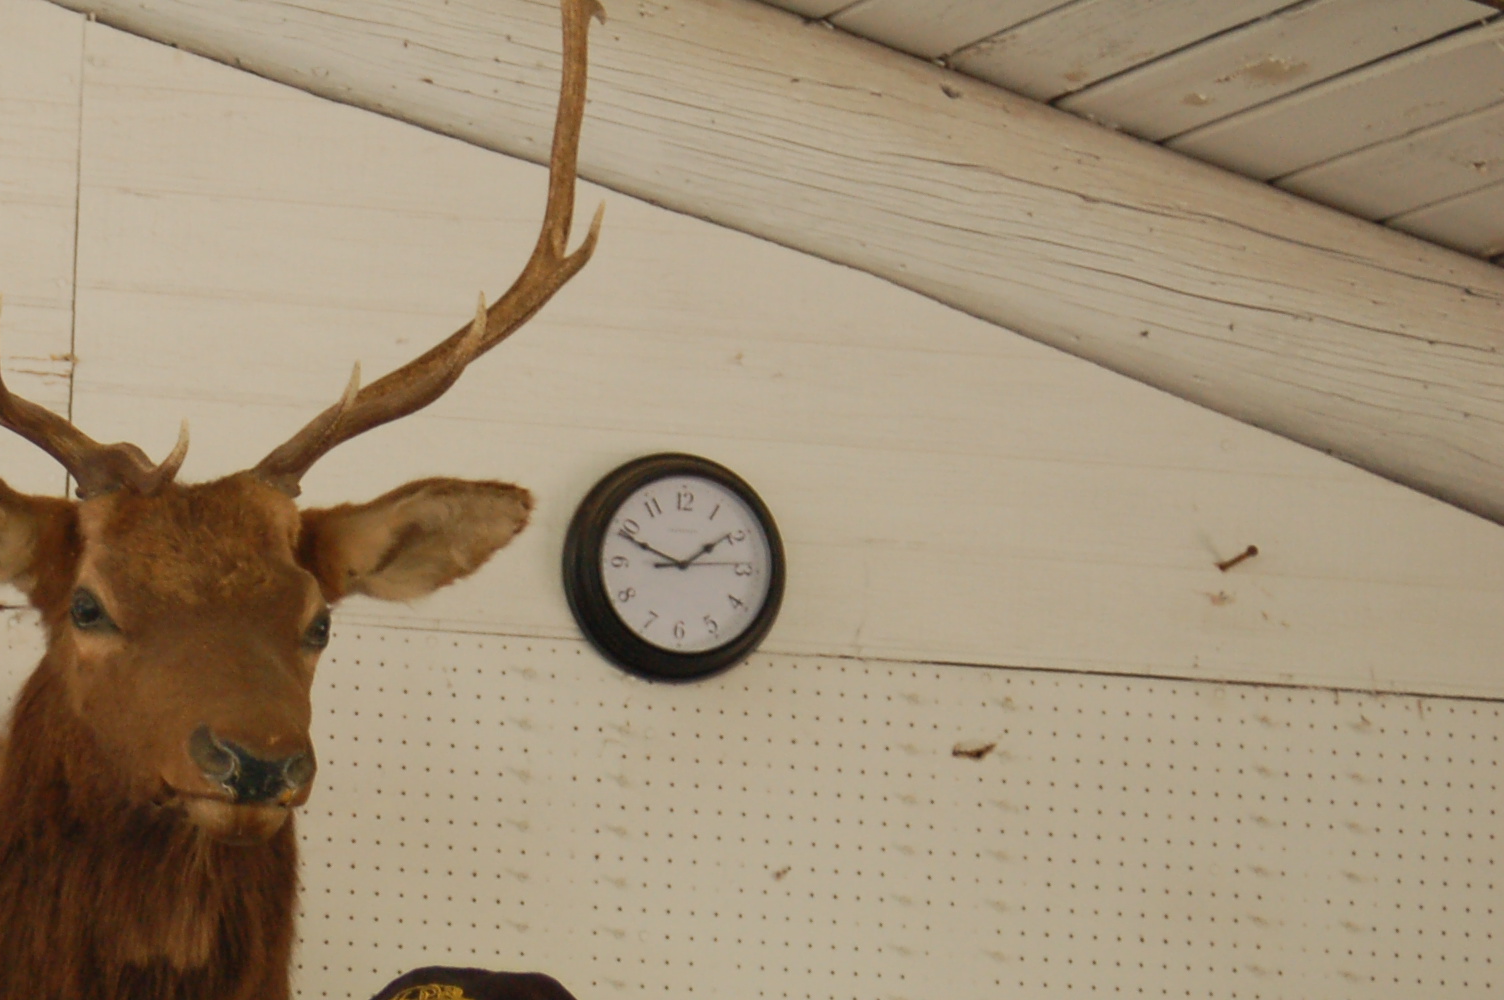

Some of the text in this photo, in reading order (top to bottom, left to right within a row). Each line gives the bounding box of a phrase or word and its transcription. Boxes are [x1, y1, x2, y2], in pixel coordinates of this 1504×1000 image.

[644, 497, 662, 518] 11
[676, 491, 694, 512] 12
[673, 620, 685, 640] 6
